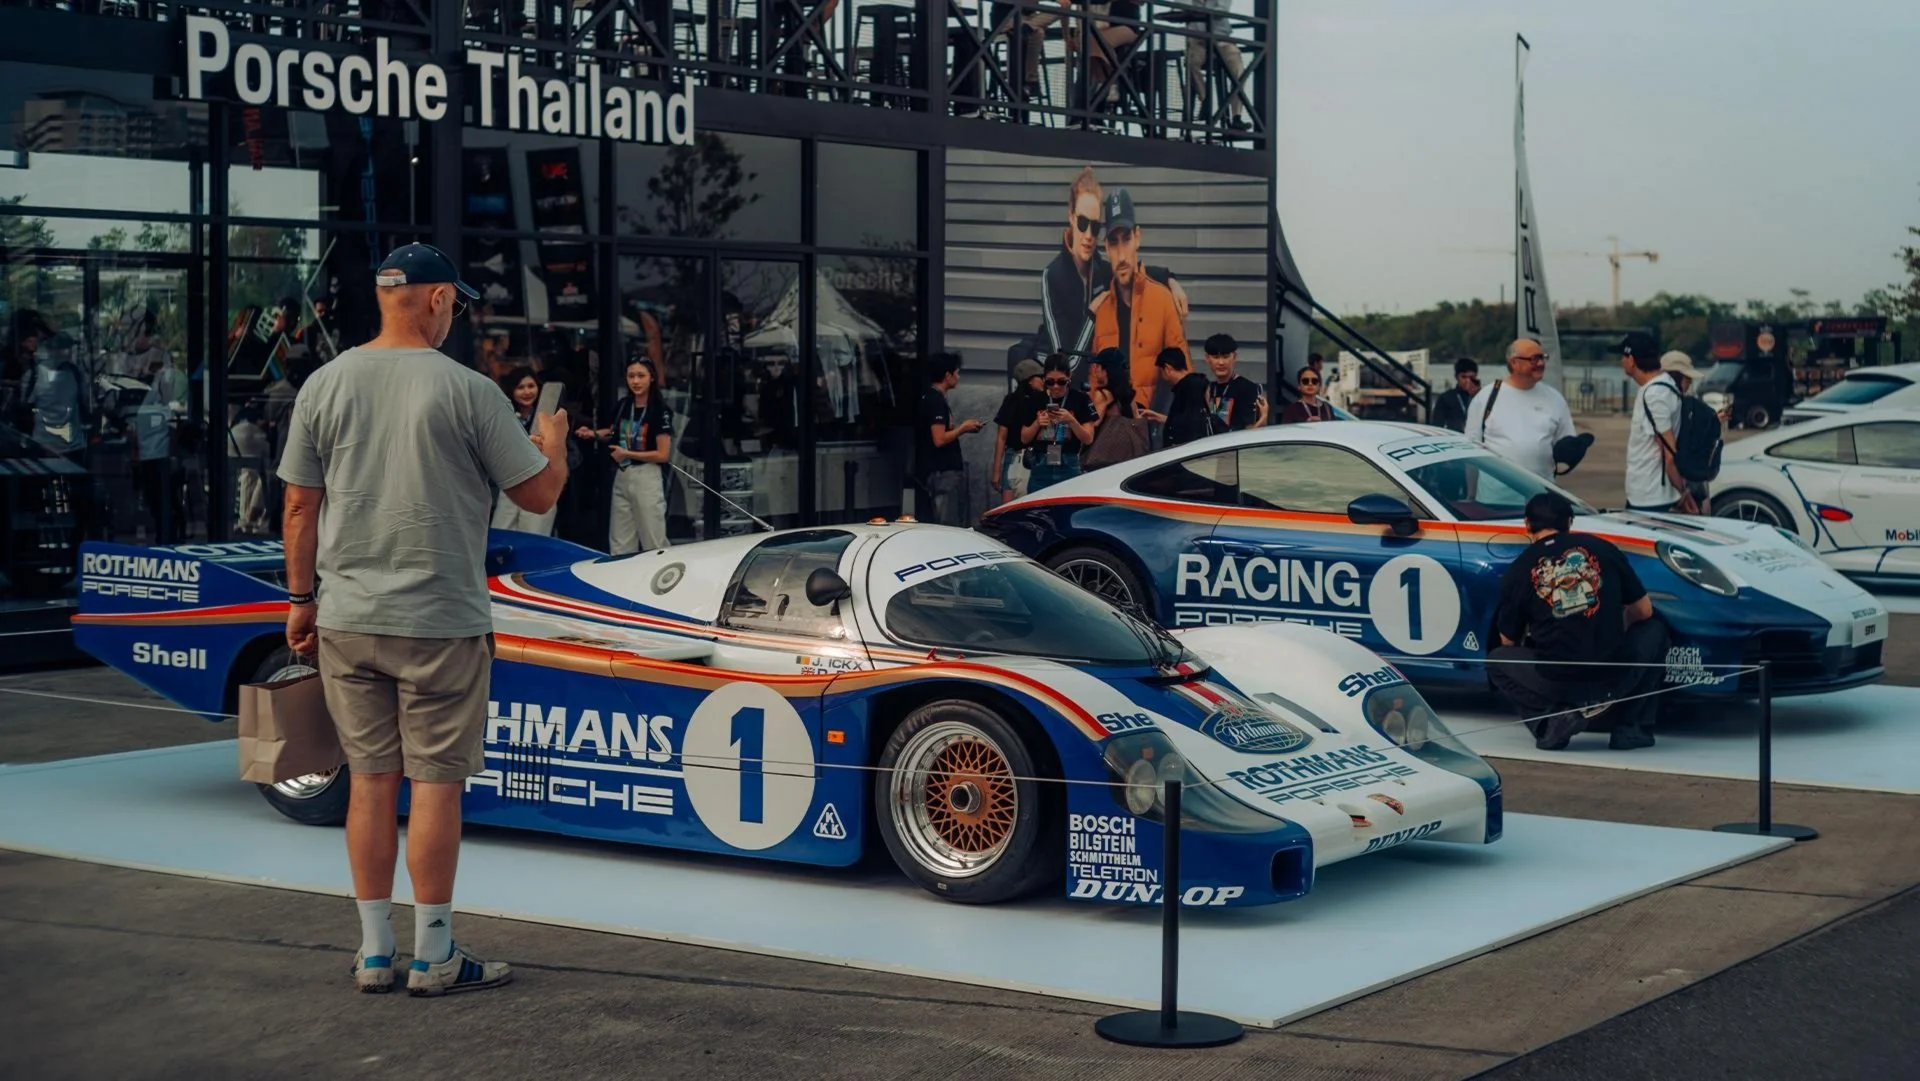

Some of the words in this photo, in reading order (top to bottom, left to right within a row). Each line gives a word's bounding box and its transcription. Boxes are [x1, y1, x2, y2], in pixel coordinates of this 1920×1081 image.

[185, 15, 448, 121] Porsche
[467, 49, 696, 146] Thailand
[83, 553, 200, 582] ROTHMANS
[1176, 553, 1361, 607] RACING
[82, 581, 199, 603] PORSCHE
[1400, 567, 1422, 641] 1
[132, 642, 207, 670] Shell
[812, 658, 823, 667] J.
[828, 659, 863, 671] ICKX
[1338, 666, 1402, 697] Shell
[486, 701, 674, 762] HMANS
[1096, 712, 1154, 731] She
[730, 706, 765, 824] 1
[1226, 745, 1389, 790] ROTHMANS
[1266, 765, 1419, 805] PORSCHE
[1069, 814, 1135, 834] BOSCH
[1361, 820, 1442, 853] DUNLOP
[1069, 832, 1136, 853] BILSTEIN
[1069, 851, 1142, 866] SCHMITTHELM
[1069, 863, 1158, 882] TELETRON
